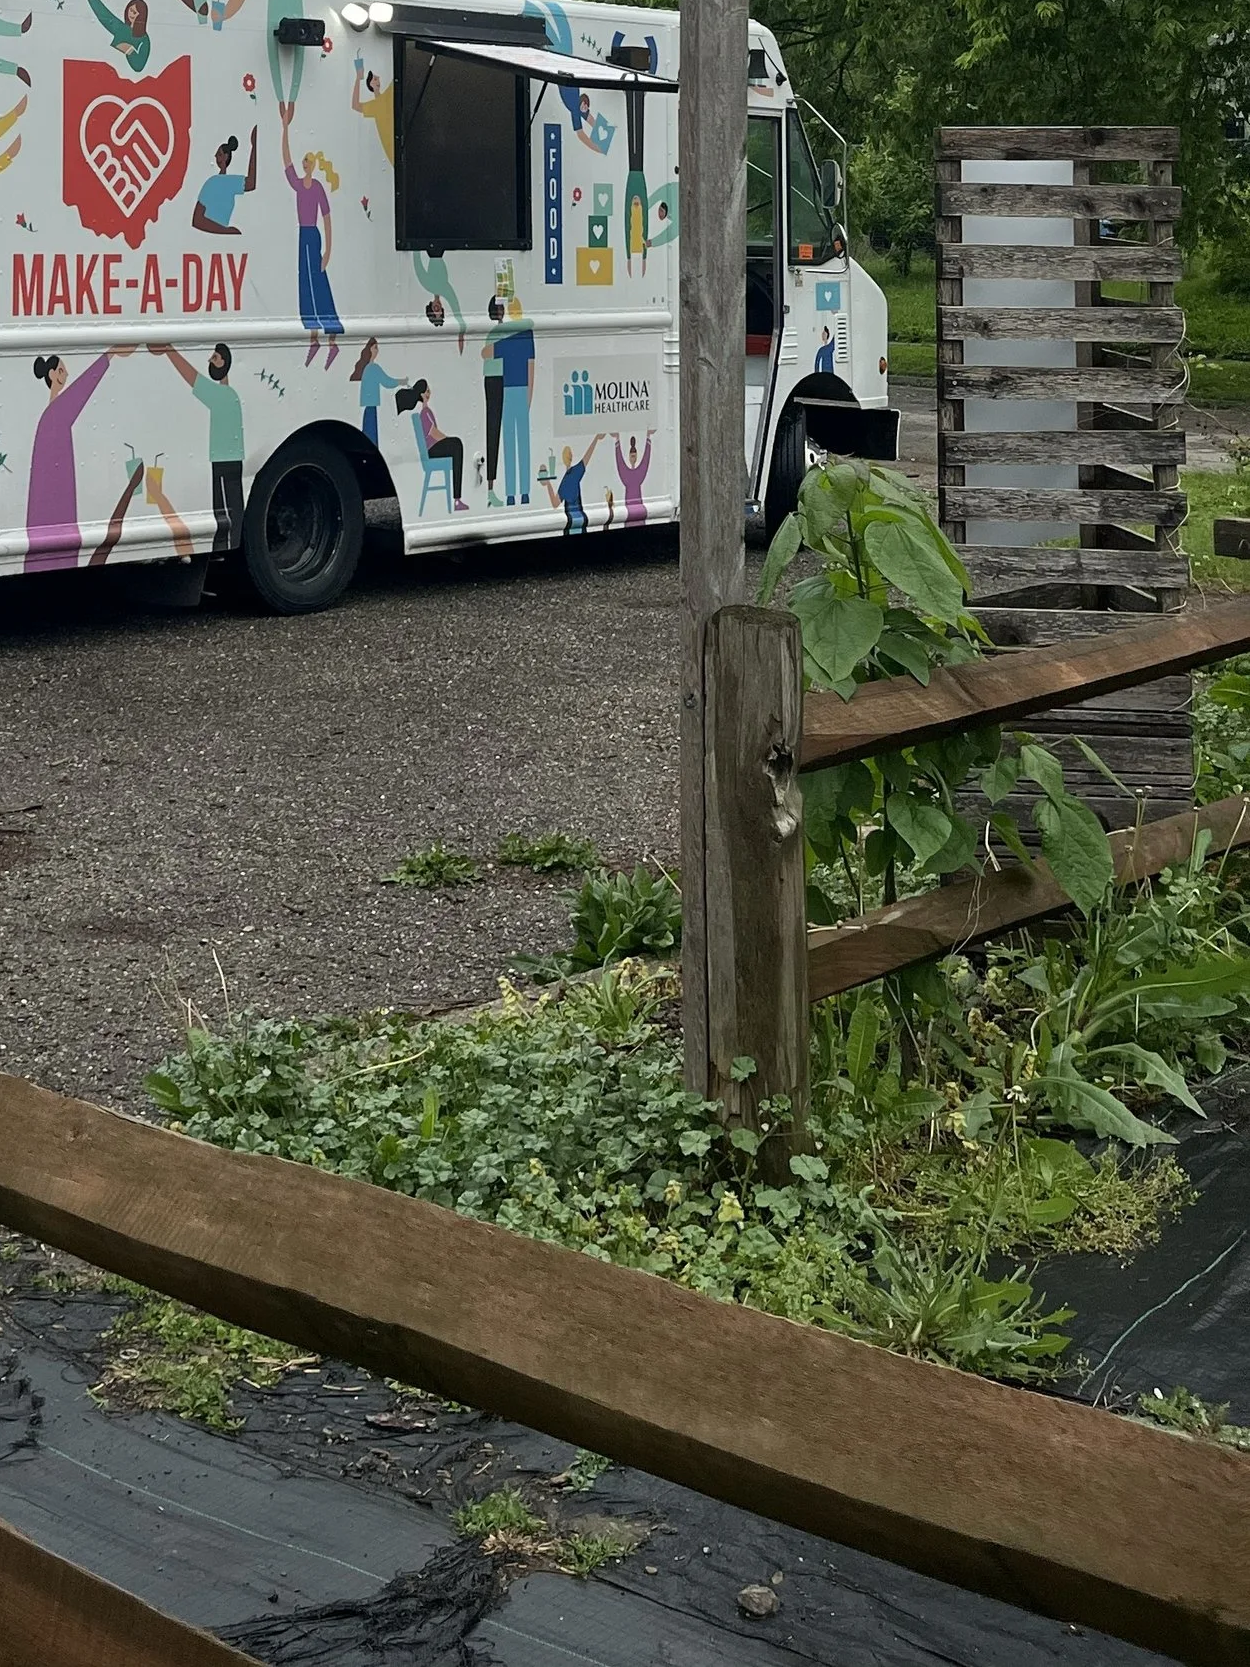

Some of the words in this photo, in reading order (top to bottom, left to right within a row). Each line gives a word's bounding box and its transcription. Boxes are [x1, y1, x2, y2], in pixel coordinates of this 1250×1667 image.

[549, 148, 558, 260] FOOD
[12, 252, 249, 316] MAKE-A-DAY
[594, 380, 649, 401] MOLINA
[594, 399, 650, 414] HEALTHCARE
